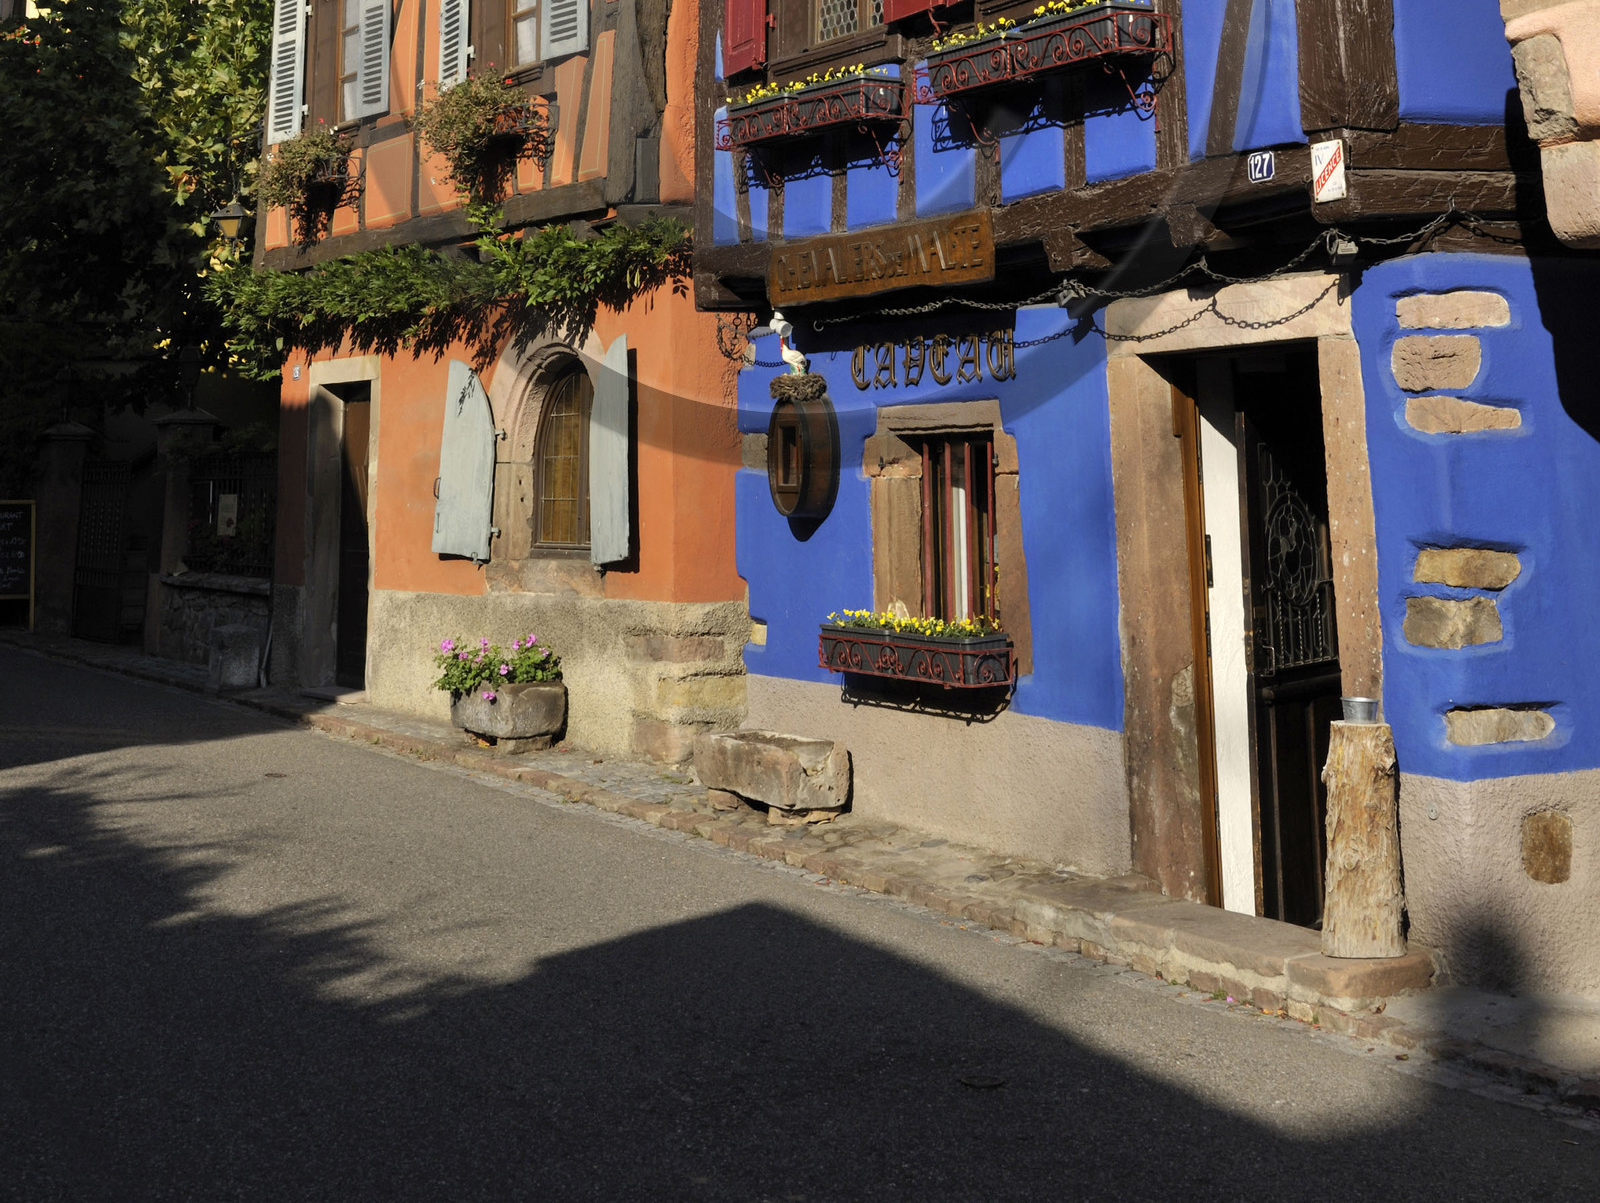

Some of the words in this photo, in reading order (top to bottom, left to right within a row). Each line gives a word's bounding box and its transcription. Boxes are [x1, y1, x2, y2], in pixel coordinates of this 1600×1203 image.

[1249, 153, 1271, 180] 127
[1315, 147, 1341, 195] LICENCE
[777, 239, 887, 292] CHEVALIERS
[903, 224, 984, 275] MALTE
[850, 328, 1016, 391] CAVEAU
